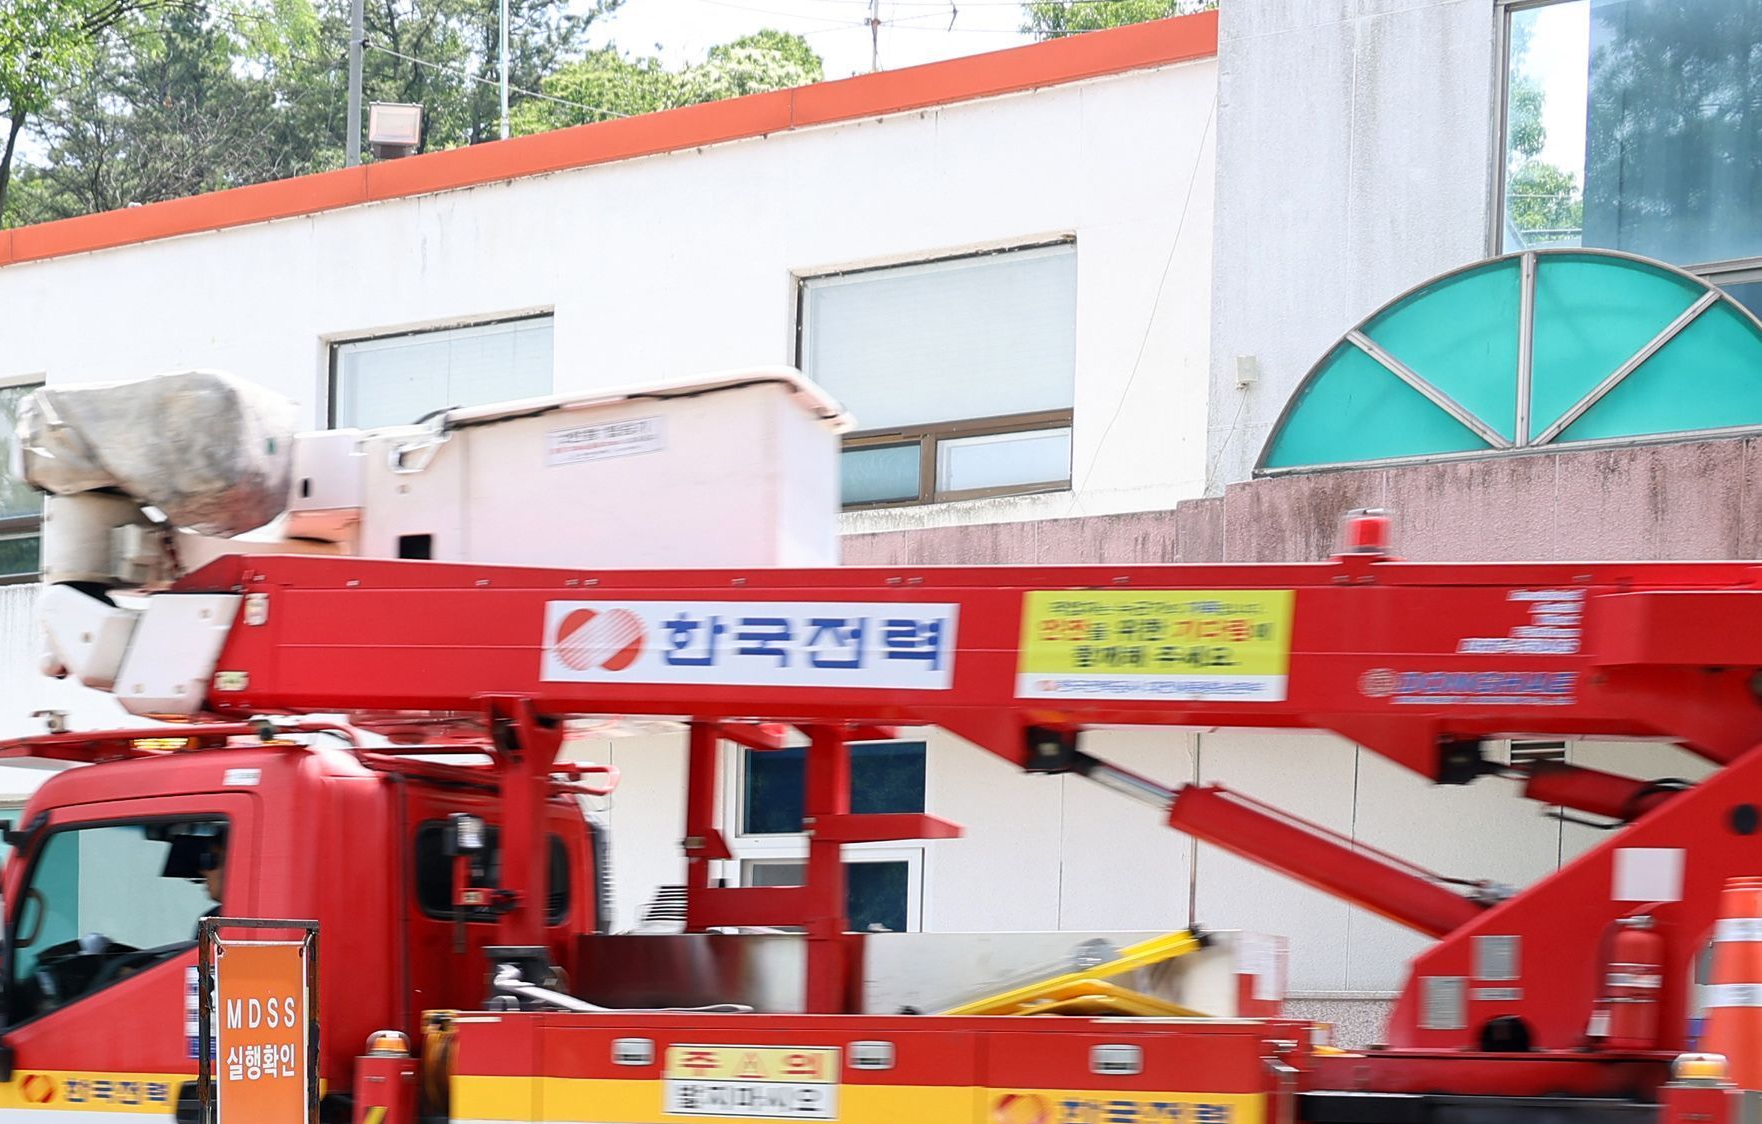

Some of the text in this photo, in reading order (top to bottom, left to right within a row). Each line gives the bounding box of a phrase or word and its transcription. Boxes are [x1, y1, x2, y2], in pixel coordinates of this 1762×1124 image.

[659, 612, 950, 671] 한국전력
[227, 997, 296, 1029] MDSS
[226, 1043, 295, 1081] 실행확인
[63, 1078, 170, 1106] 한국전력
